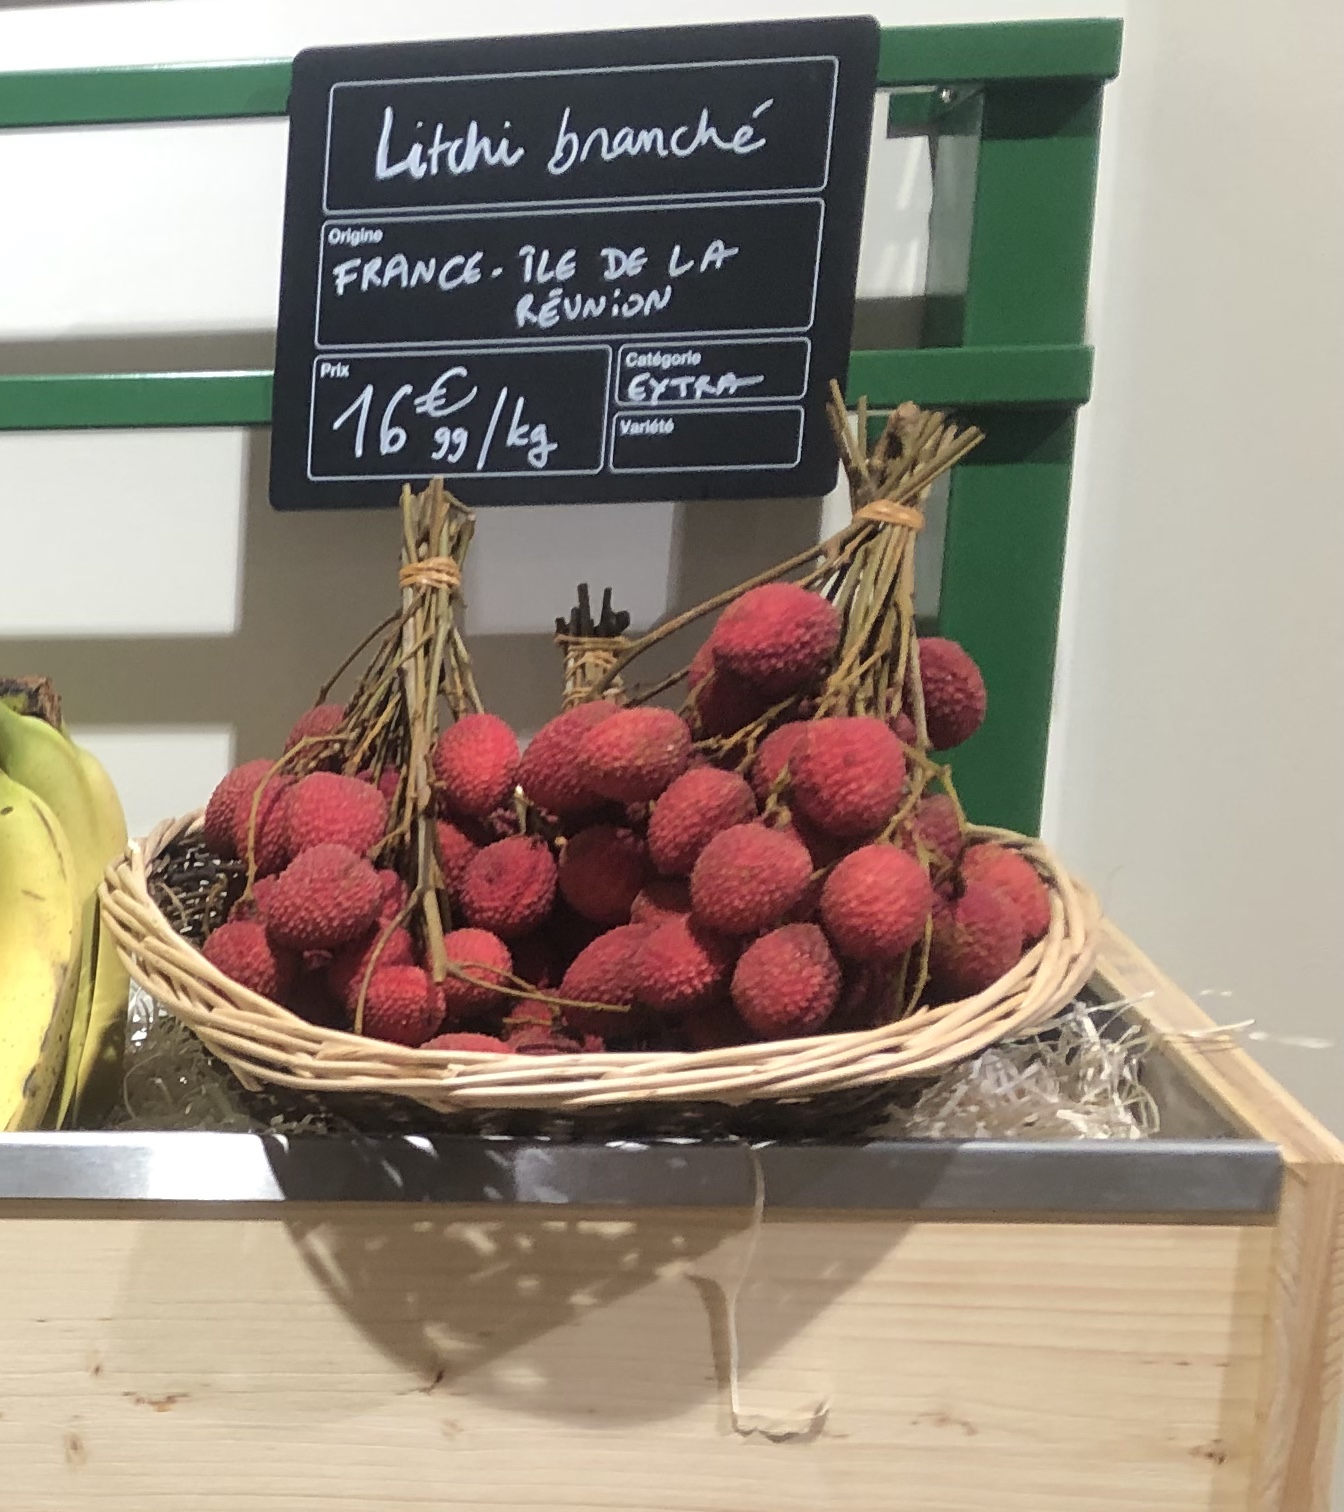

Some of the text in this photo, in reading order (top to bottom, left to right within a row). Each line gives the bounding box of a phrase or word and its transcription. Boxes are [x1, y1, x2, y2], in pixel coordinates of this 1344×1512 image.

[374, 97, 775, 182] Litchi branché
[328, 227, 383, 247] Origine
[517, 245, 577, 284] ÎLE
[600, 246, 648, 280] DE
[668, 239, 741, 278] LA
[625, 349, 702, 369] Catégorie
[320, 362, 350, 379] Prix
[620, 418, 675, 436] Variété
